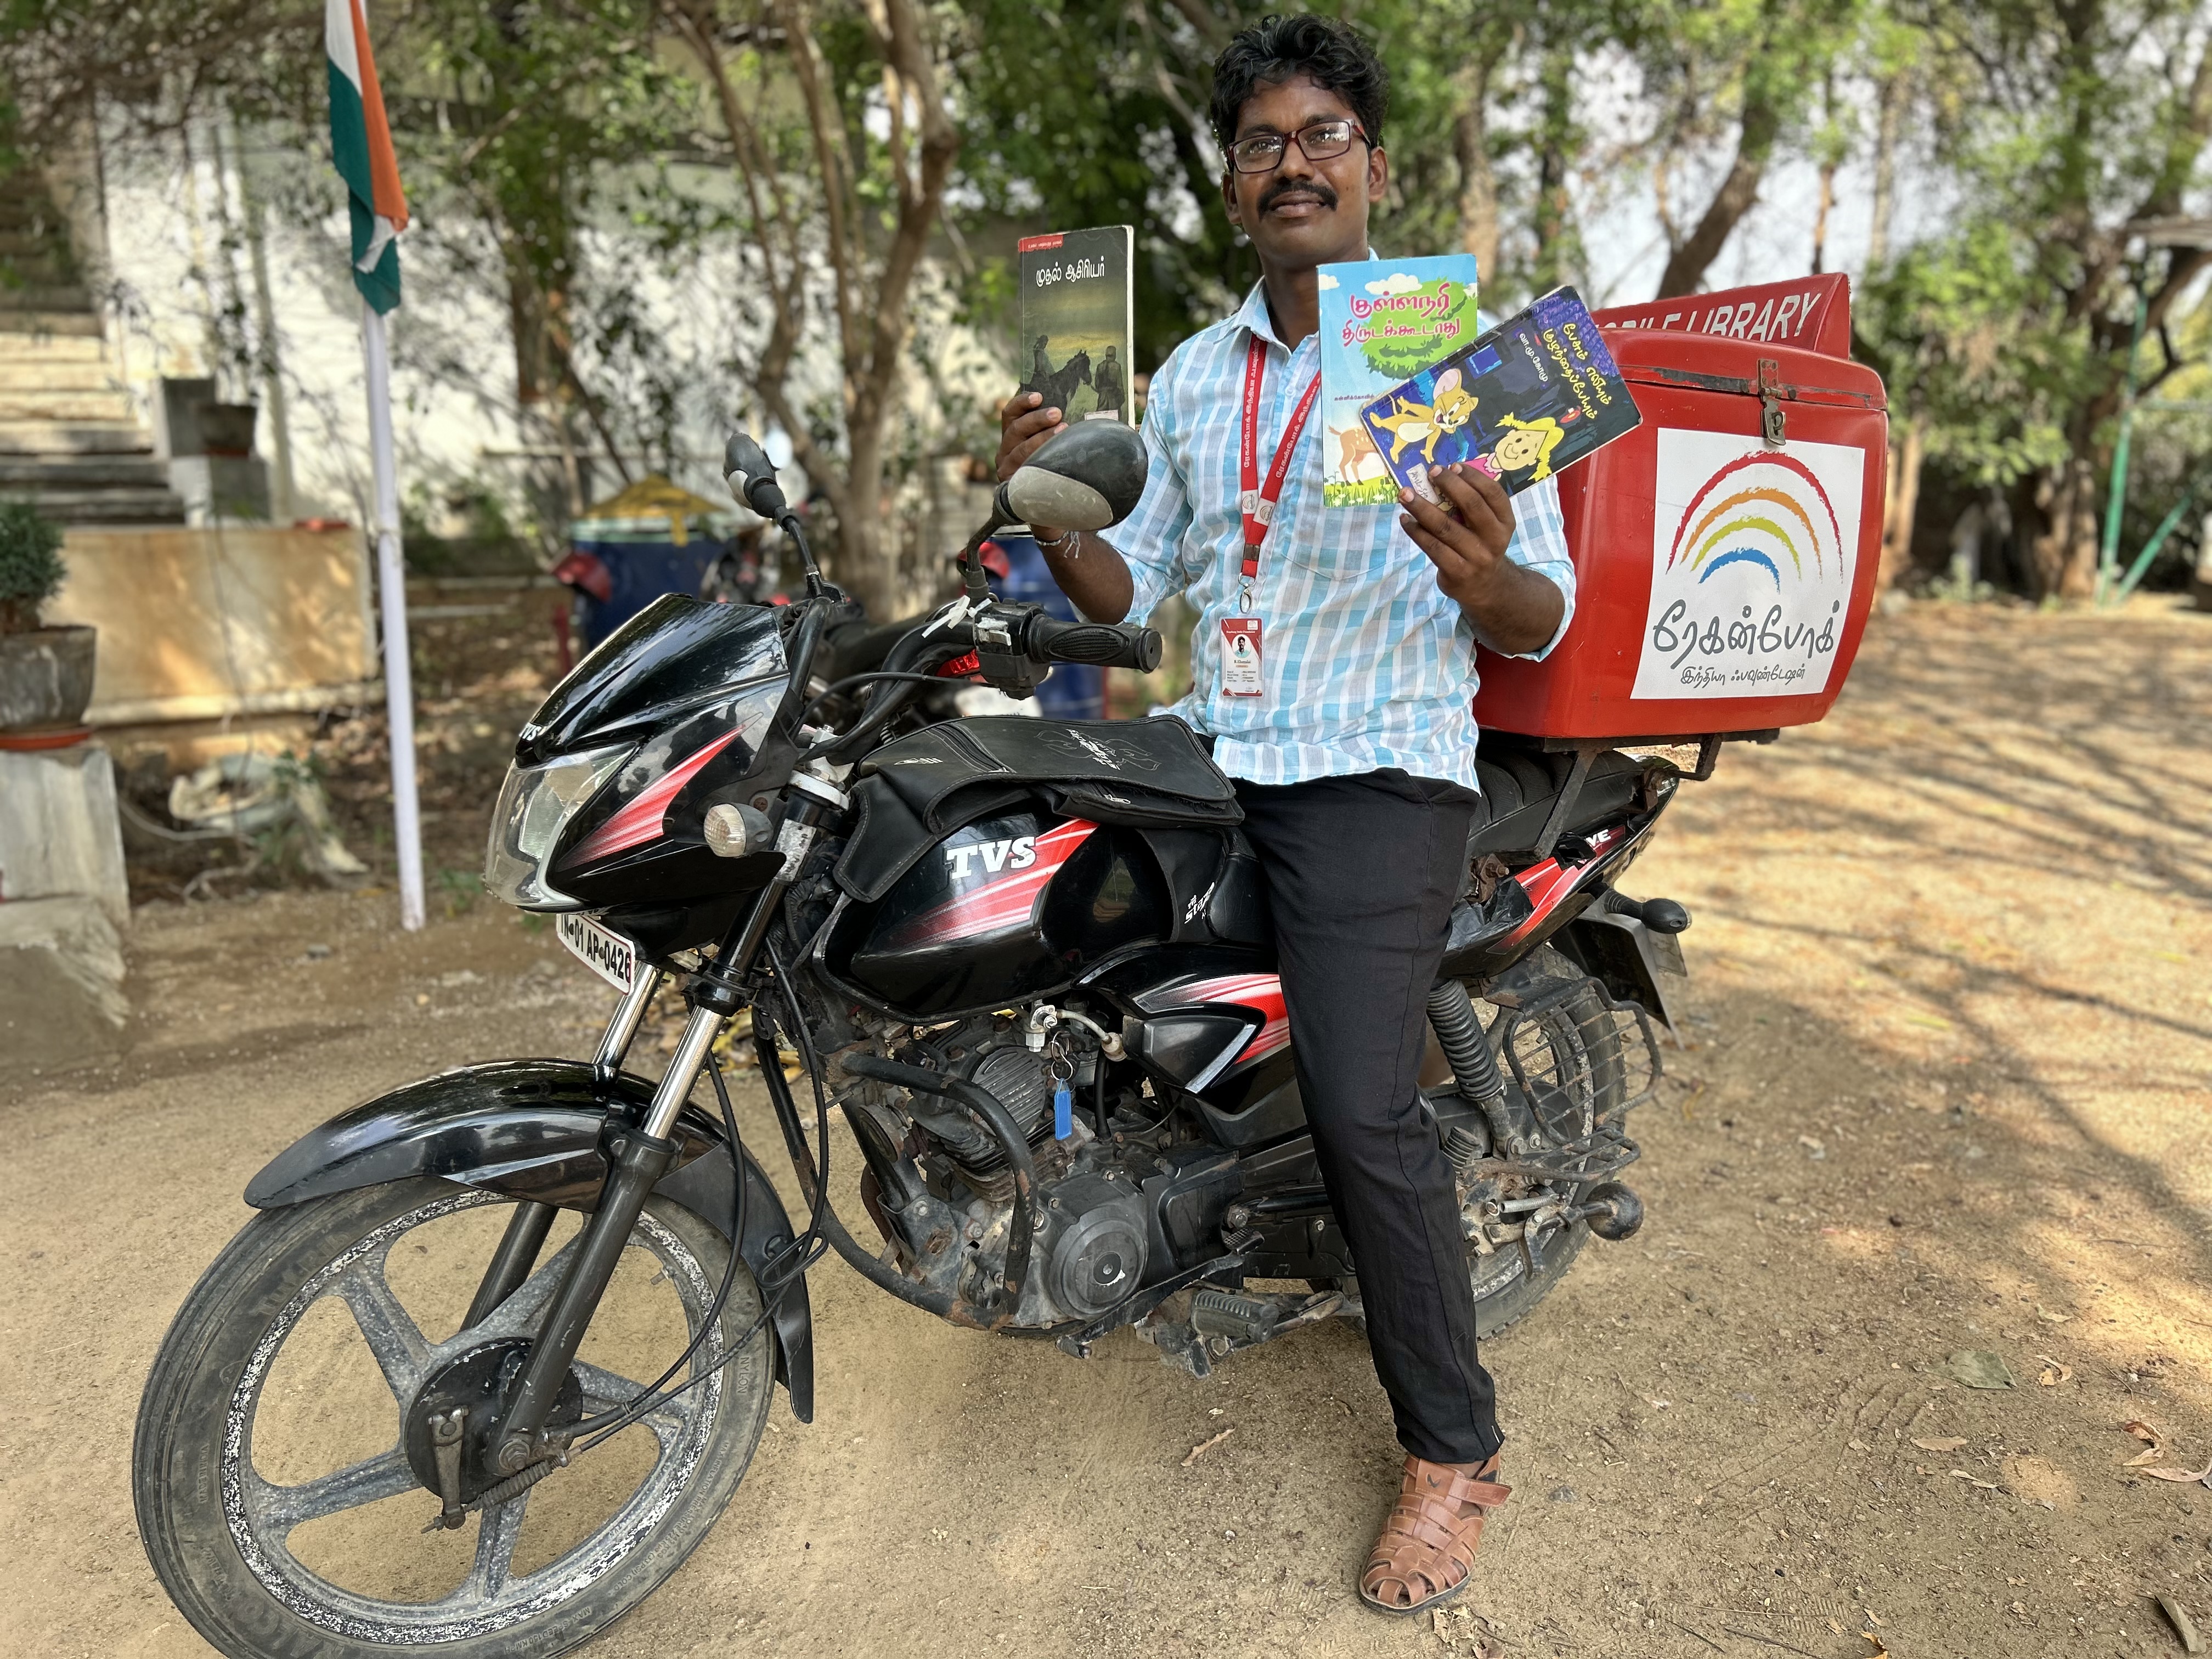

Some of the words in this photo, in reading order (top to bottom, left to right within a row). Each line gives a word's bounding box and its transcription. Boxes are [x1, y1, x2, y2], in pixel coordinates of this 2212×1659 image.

[1036, 261, 1062, 287] முதல்
[1065, 255, 1105, 283] ஆசிரியர்
[1350, 282, 1451, 319] குள்ளநரி
[1342, 318, 1460, 347] திருடக்கூடாது
[1543, 328, 1598, 419] குழந்தைப்பேயும்
[1564, 323, 1588, 360] பேசும்
[1586, 366, 1612, 405] எலியும்
[1653, 599, 1840, 669] ரேகன்போக்
[1680, 665, 1725, 689] இந்தியா
[1730, 663, 1805, 686] ஃபவுண்டேஷன்
[946, 836, 1036, 879] TVS
